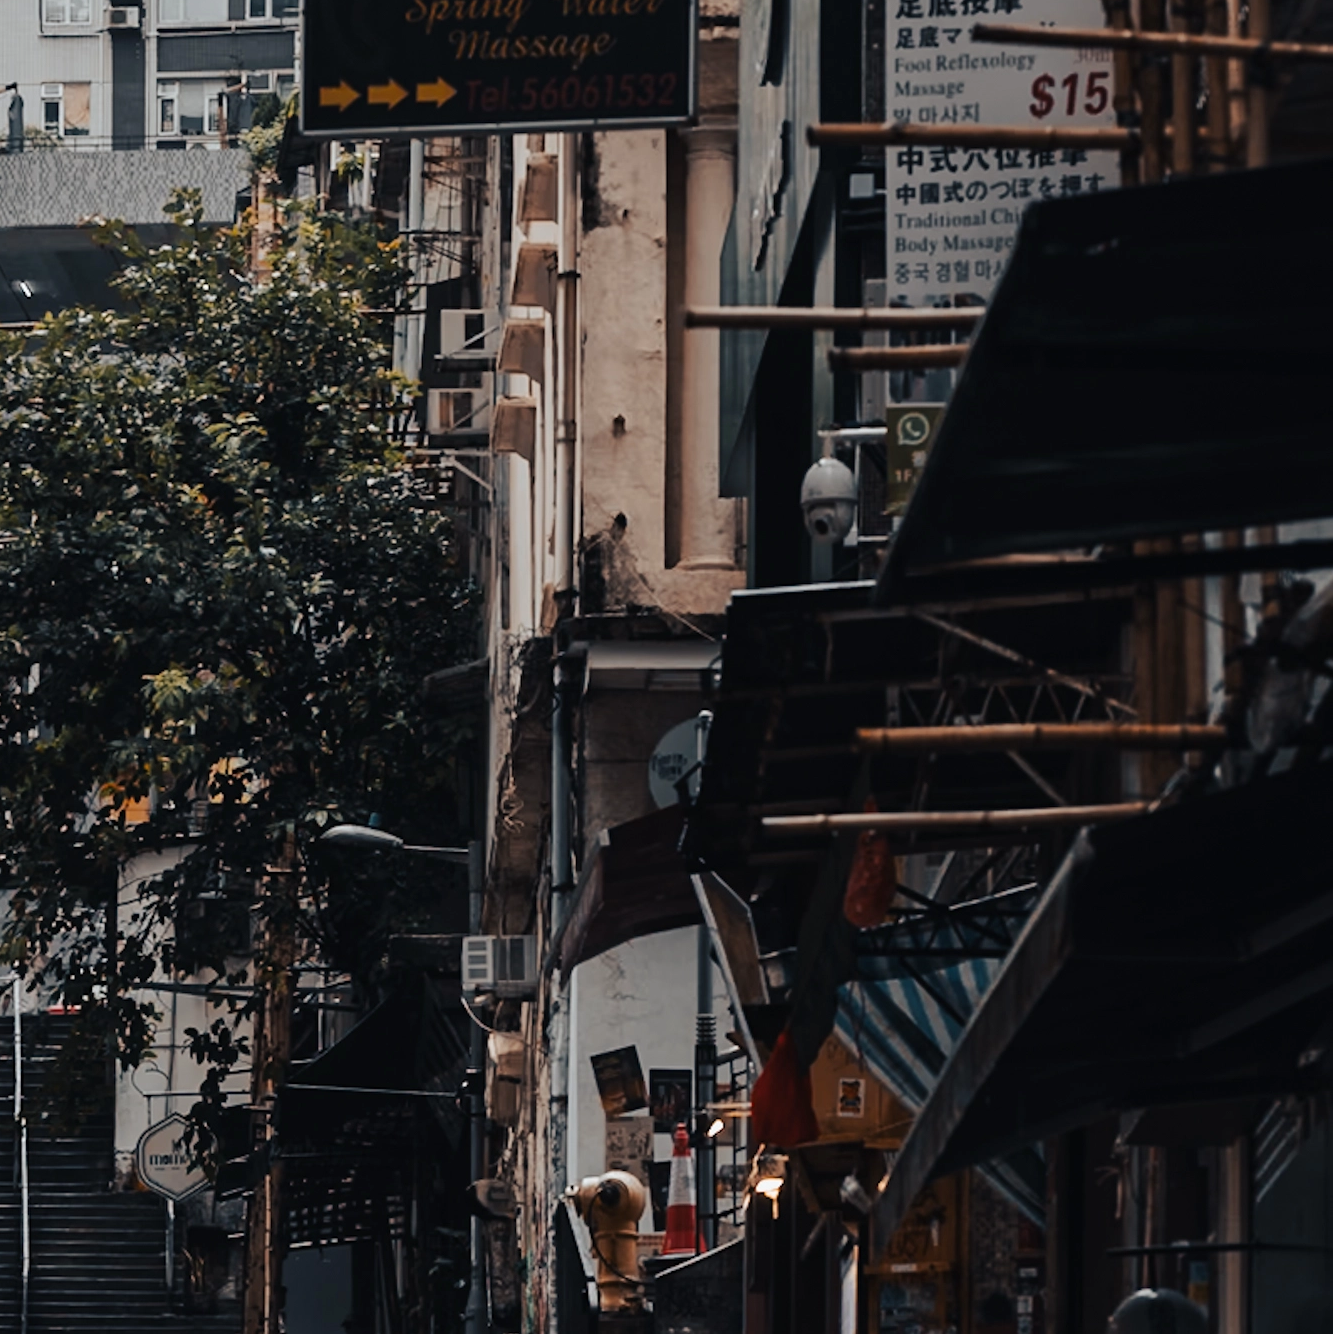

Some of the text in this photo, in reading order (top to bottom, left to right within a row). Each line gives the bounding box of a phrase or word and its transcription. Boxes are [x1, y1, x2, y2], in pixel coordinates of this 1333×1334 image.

[448, 28, 618, 71] Massage
[895, 51, 1037, 74] Foot Reflexology
[894, 80, 965, 99] Massage
[918, 102, 980, 125] 마사지
[895, 209, 986, 229] Traditional
[894, 233, 1015, 256] Body Massage
